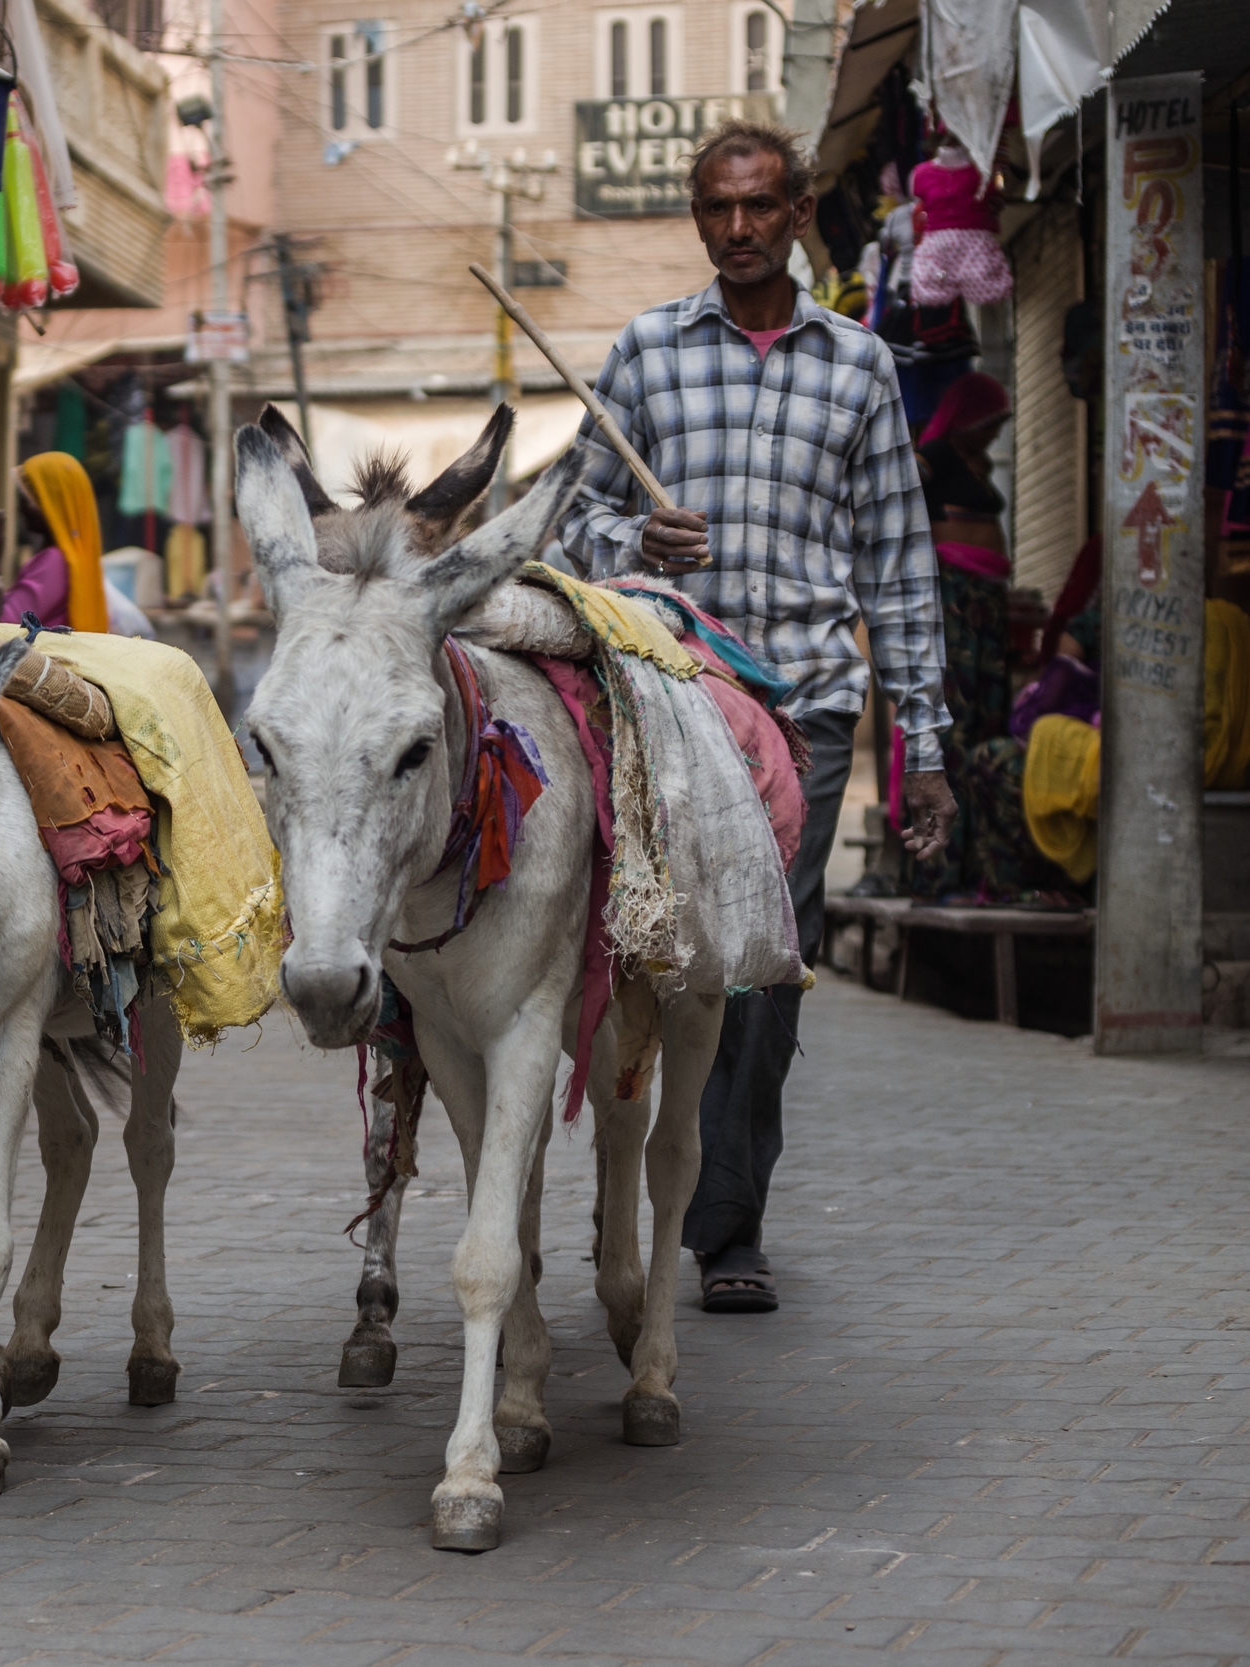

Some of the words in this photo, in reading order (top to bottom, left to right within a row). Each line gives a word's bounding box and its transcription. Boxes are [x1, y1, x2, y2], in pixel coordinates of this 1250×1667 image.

[1115, 97, 1196, 139] HOTEL
[579, 137, 698, 178] EVER
[1124, 621, 1192, 658] GUEST
